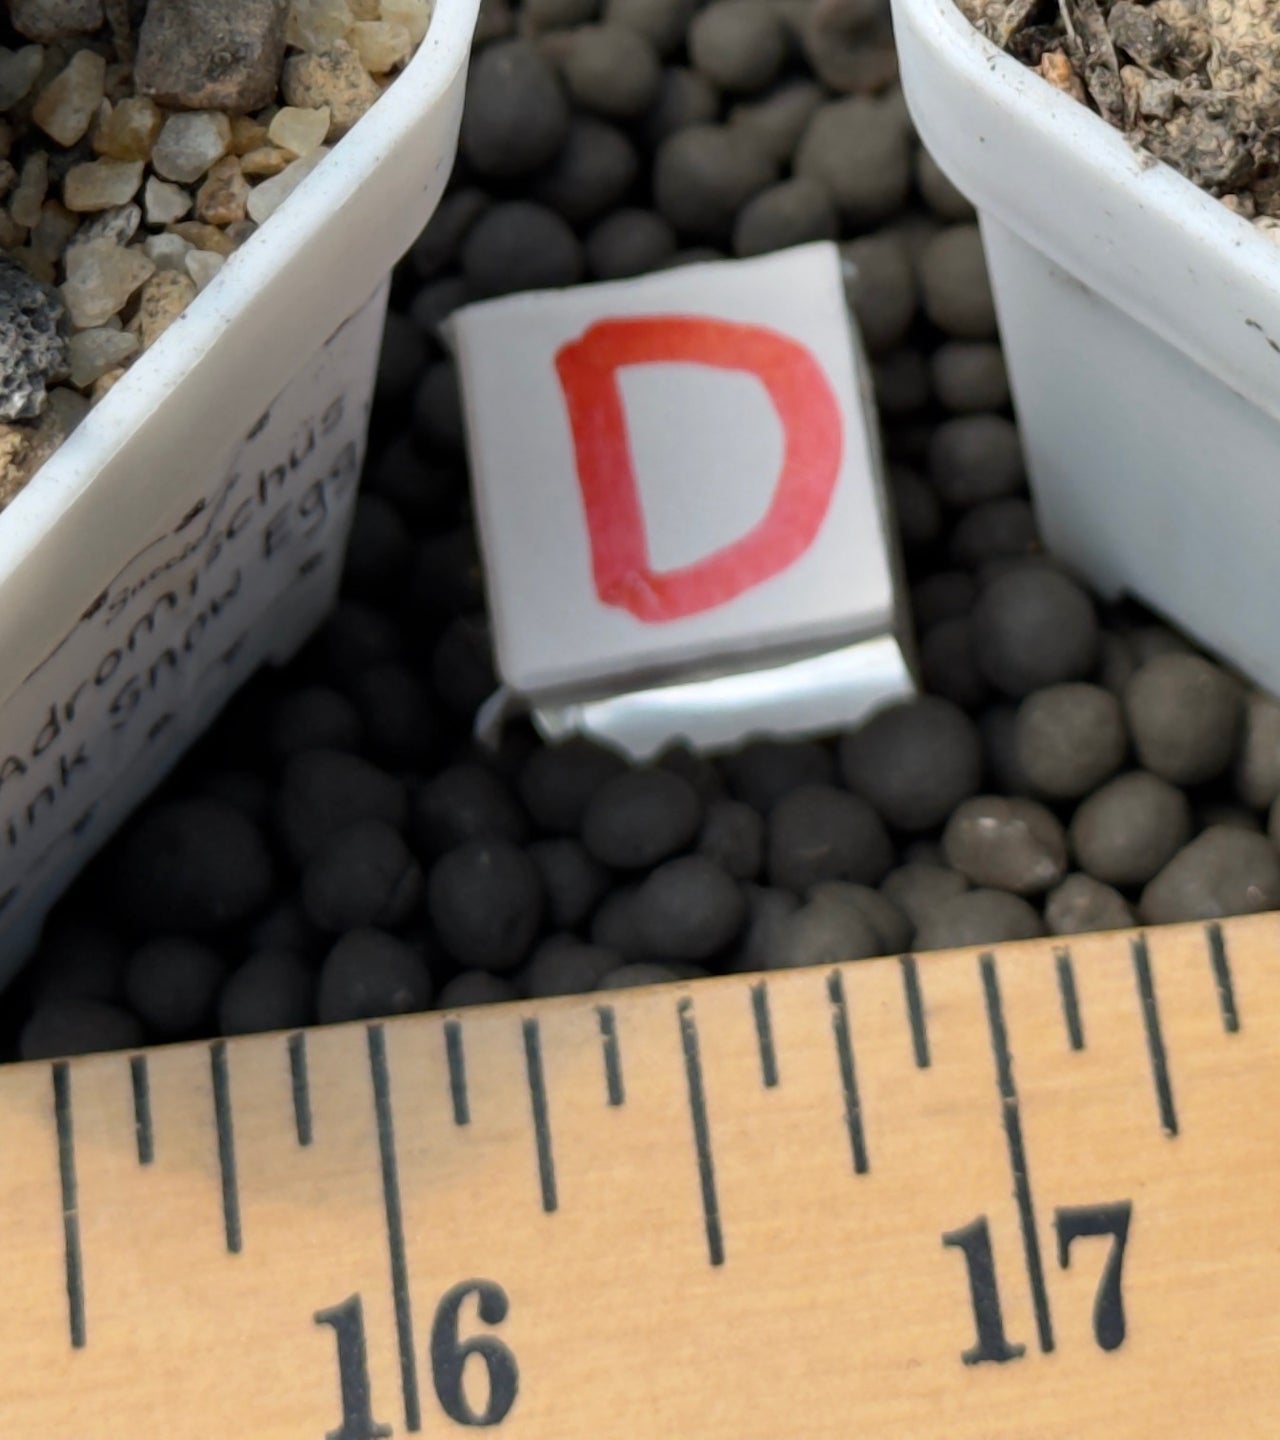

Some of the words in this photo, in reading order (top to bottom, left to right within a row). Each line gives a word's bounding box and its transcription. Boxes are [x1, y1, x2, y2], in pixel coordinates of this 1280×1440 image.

[554, 312, 846, 626] D
[108, 567, 242, 732] Snow
[313, 1276, 520, 1440] 16
[941, 1198, 1132, 1367] 17
